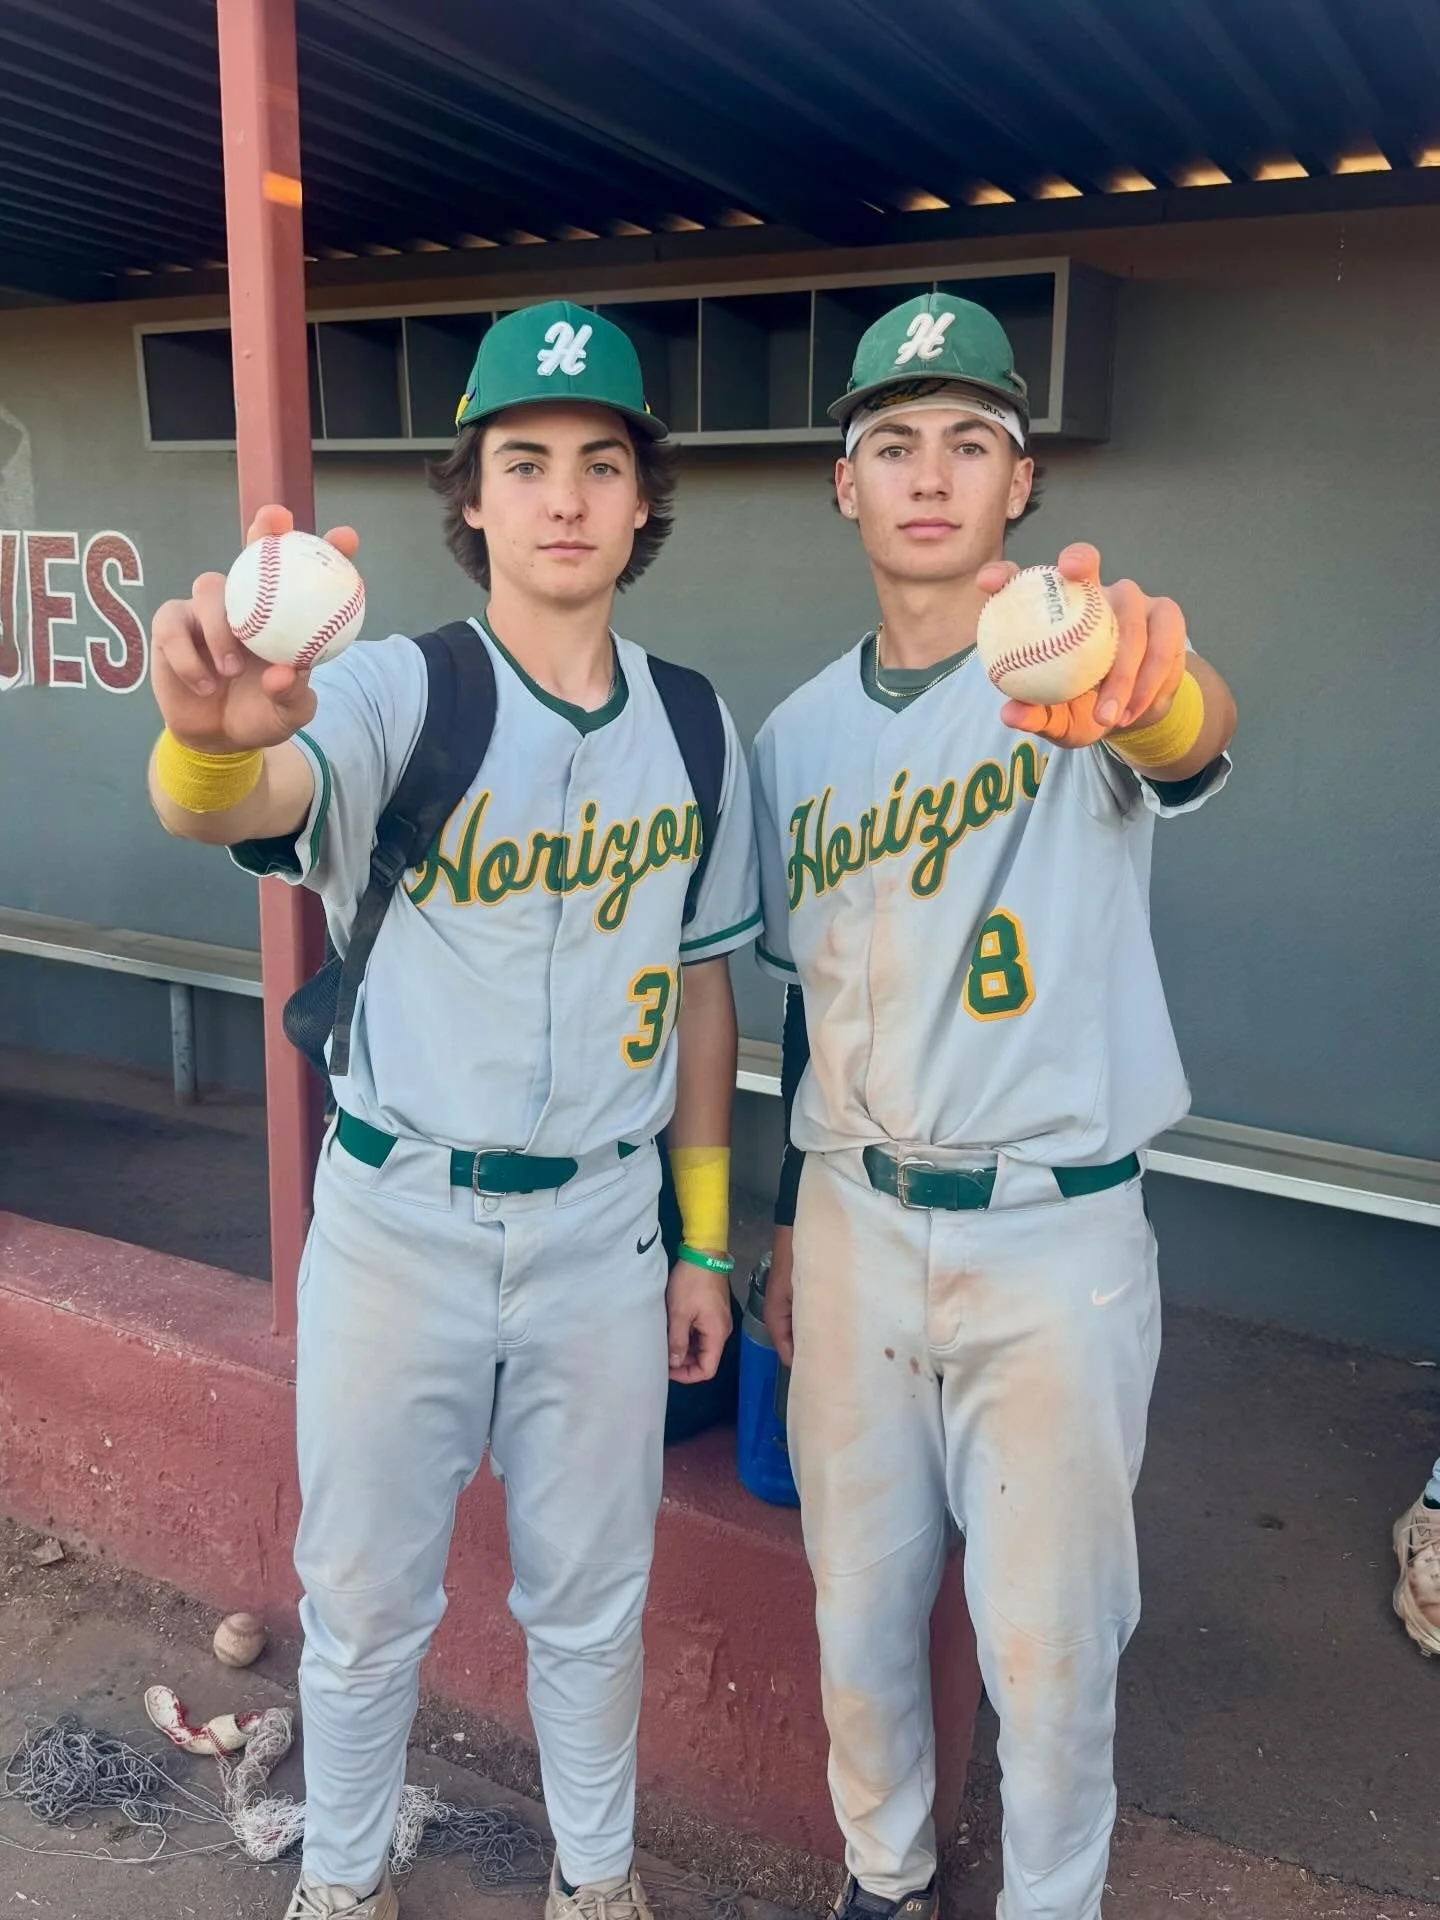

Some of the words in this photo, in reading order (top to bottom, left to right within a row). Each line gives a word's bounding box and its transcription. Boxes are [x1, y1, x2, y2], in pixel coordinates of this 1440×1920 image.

[535, 320, 593, 376] H
[894, 311, 957, 366] H
[402, 787, 704, 934] Horizon
[787, 739, 1049, 914] Horizon
[620, 963, 683, 1071] 3
[959, 906, 1037, 1024] 8
